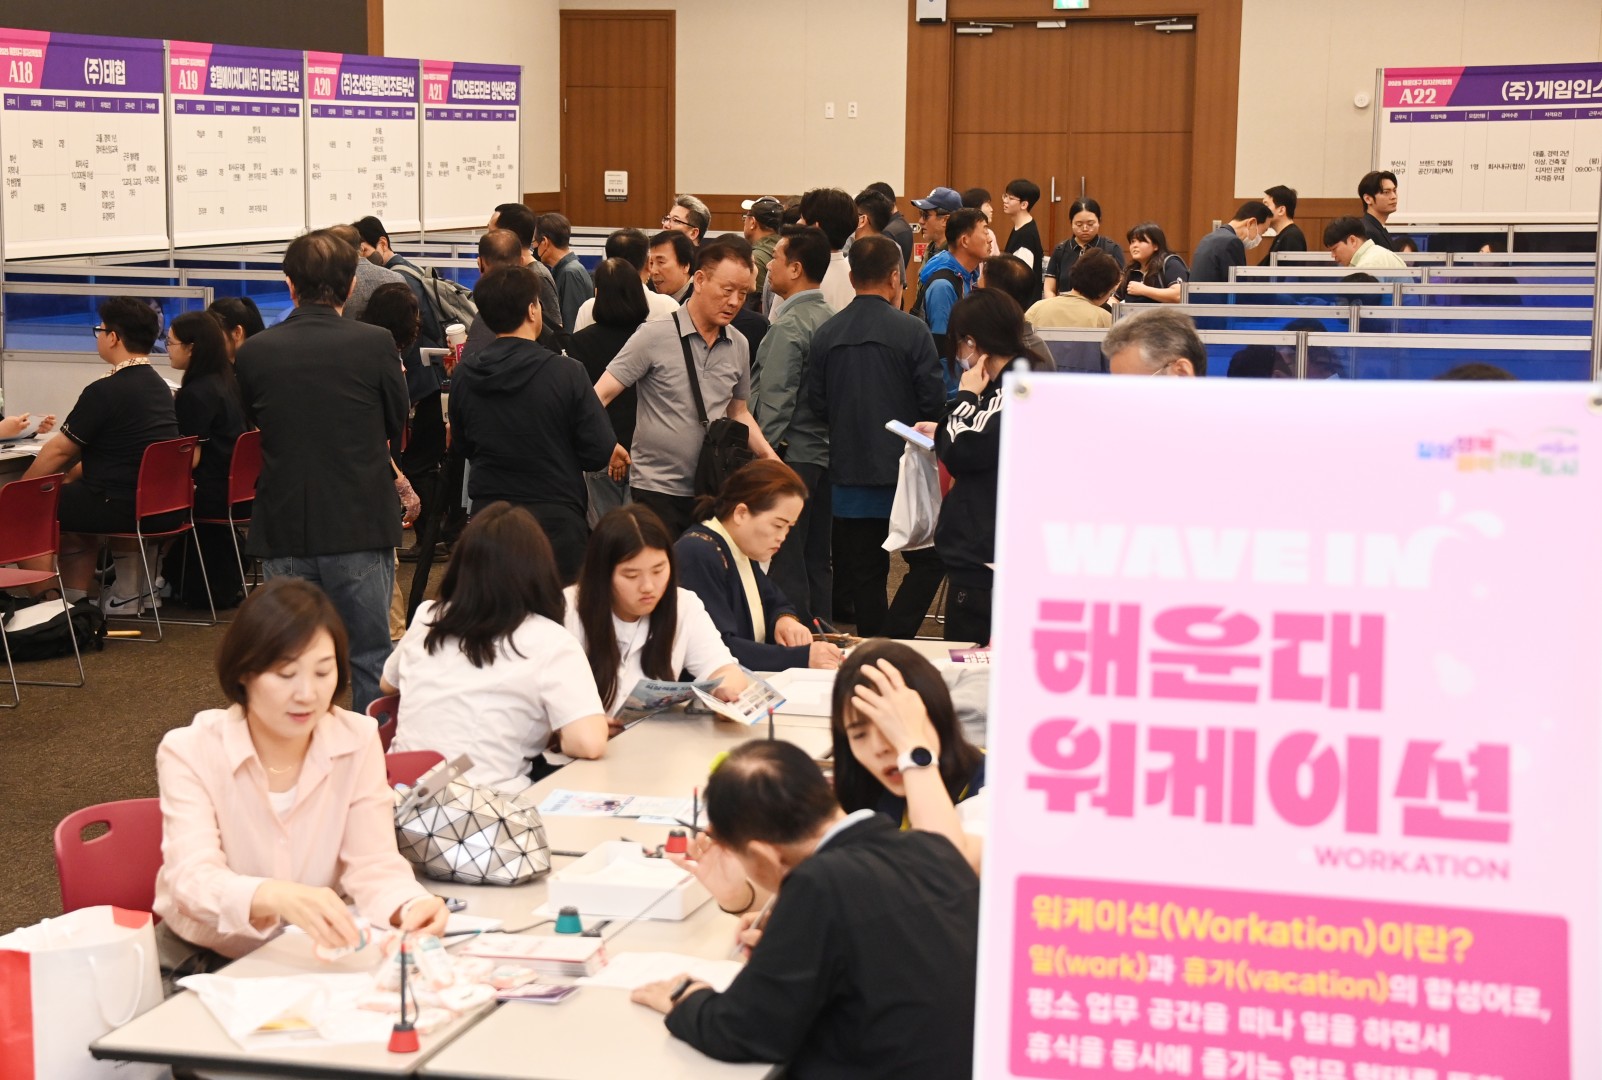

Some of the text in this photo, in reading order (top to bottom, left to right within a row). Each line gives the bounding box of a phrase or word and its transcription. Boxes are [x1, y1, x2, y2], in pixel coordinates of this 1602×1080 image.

[8, 60, 34, 84] A18
[178, 69, 198, 90] A19
[288, 70, 300, 93] 부산
[313, 77, 331, 96] A20
[428, 83, 443, 101] A21
[1399, 88, 1437, 104] A22
[1041, 521, 1433, 590] WAVE IN
[1032, 598, 1386, 713] 해운대
[1025, 717, 1513, 844] 워케이션
[1313, 845, 1511, 881] WORKATION
[1031, 894, 1474, 963] 워케이션(Workation)이란?
[1028, 944, 1553, 1024] 일(work)과 휴가(vacation)의 합성어로,
[1027, 987, 1081, 1020] 평소
[1085, 991, 1140, 1026] 업무
[1148, 997, 1229, 1035] 공간을
[1301, 1010, 1357, 1048] 일을
[1363, 1016, 1451, 1057] 하면서
[1025, 1031, 1104, 1069] 휴식을
[1110, 1037, 1193, 1077] 동시에
[1201, 1046, 1285, 1080] 즐기는
